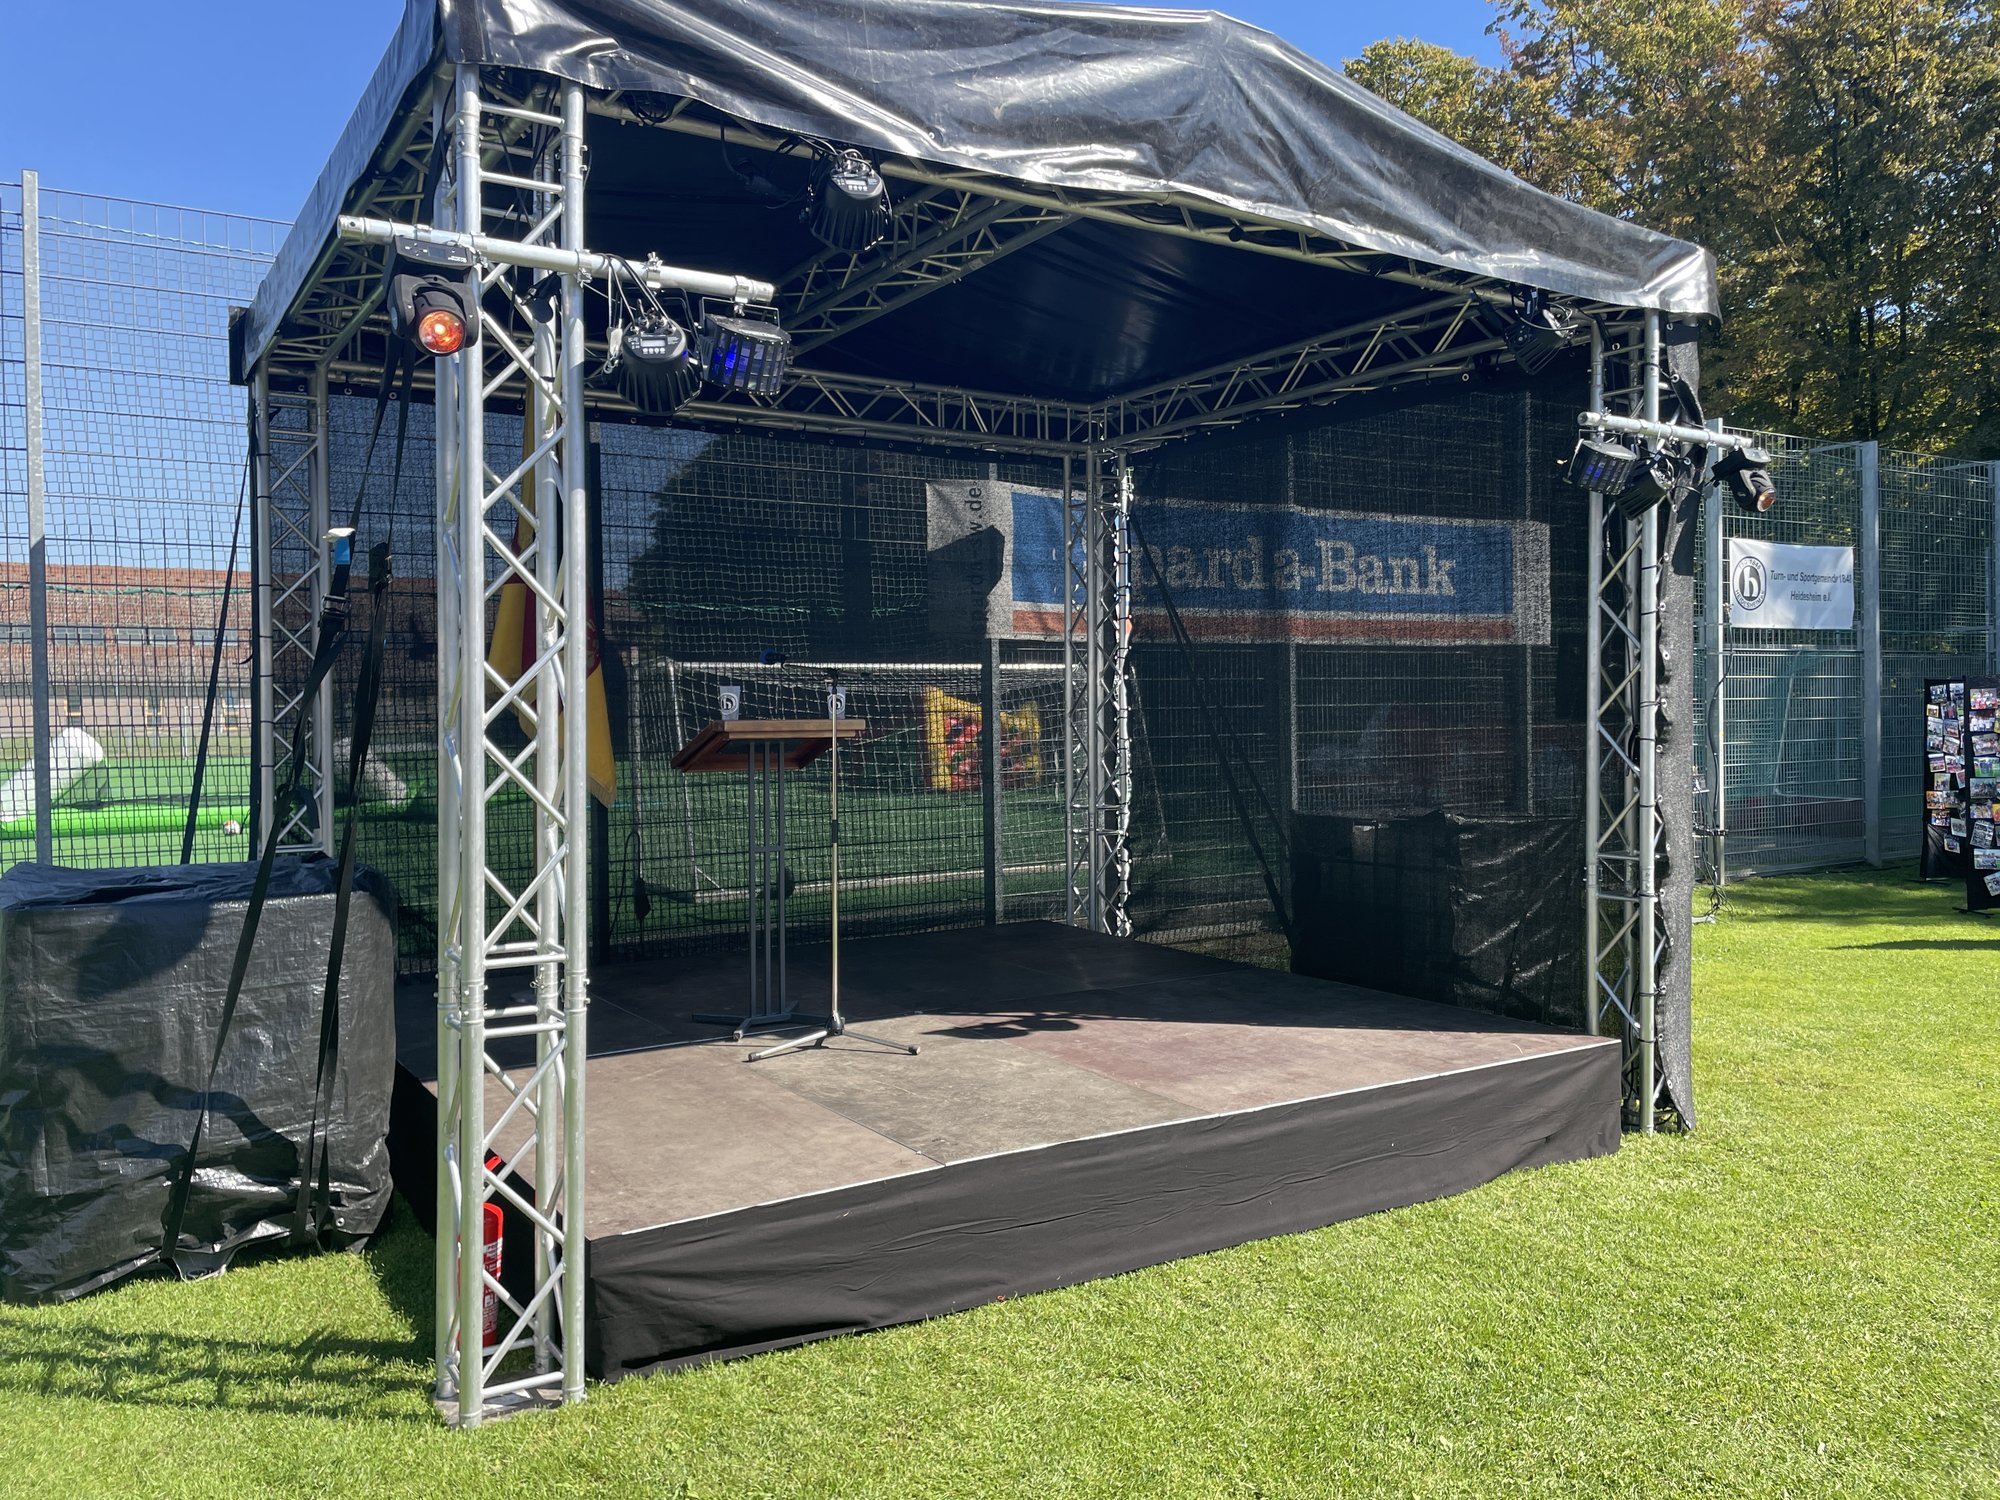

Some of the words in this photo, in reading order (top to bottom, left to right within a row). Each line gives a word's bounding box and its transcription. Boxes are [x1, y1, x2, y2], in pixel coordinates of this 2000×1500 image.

[1086, 534, 1457, 604] parda-Bank
[1770, 570, 1786, 581] Turn-
[1787, 571, 1799, 582] und
[1790, 591, 1822, 602] Heidesheim
